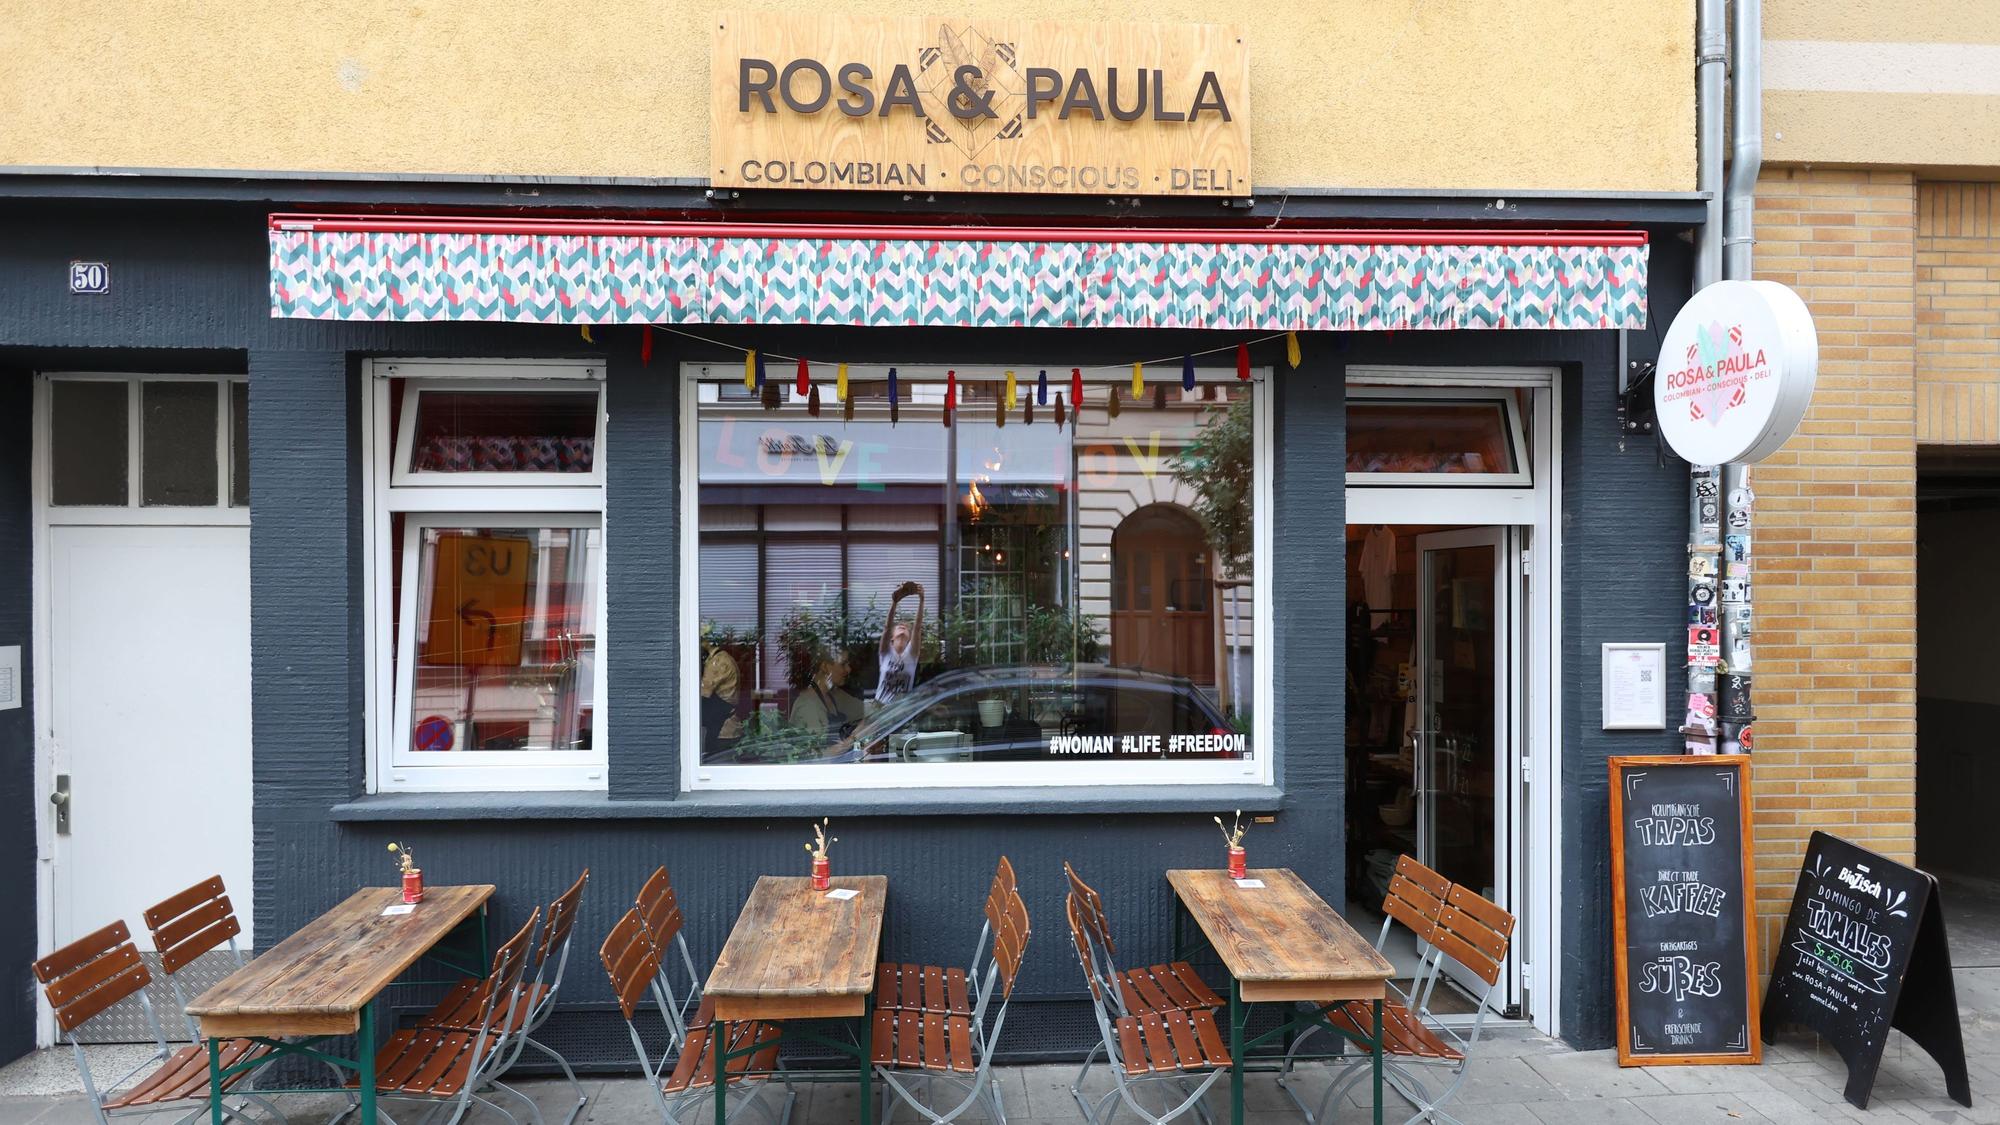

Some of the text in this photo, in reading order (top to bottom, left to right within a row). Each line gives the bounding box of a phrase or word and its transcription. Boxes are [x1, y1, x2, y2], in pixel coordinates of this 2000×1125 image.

[739, 58, 1232, 122] ROSA & PAULA
[740, 159, 1232, 191] COLOMBIAN CONSCIOUS DELI
[74, 265, 102, 289] 50
[1663, 369, 1771, 402] COLOMBIAN CONSCIOUS DELI
[1667, 349, 1766, 390] ROSA & PAULA
[1050, 734, 1245, 754] #WOMAN #LIFE #FREEDOM
[1635, 817, 1716, 846] TAPAS
[1682, 870, 1699, 882] TRADE
[1838, 866, 1882, 899] BioZisch
[1640, 883, 1726, 918] KAFFEE
[1818, 885, 1880, 924] DOMINGO DE
[1807, 898, 1892, 969] TAMALES
[1796, 952, 1866, 994] Jetzt hier oder unter
[1810, 993, 1839, 1013] anmelden
